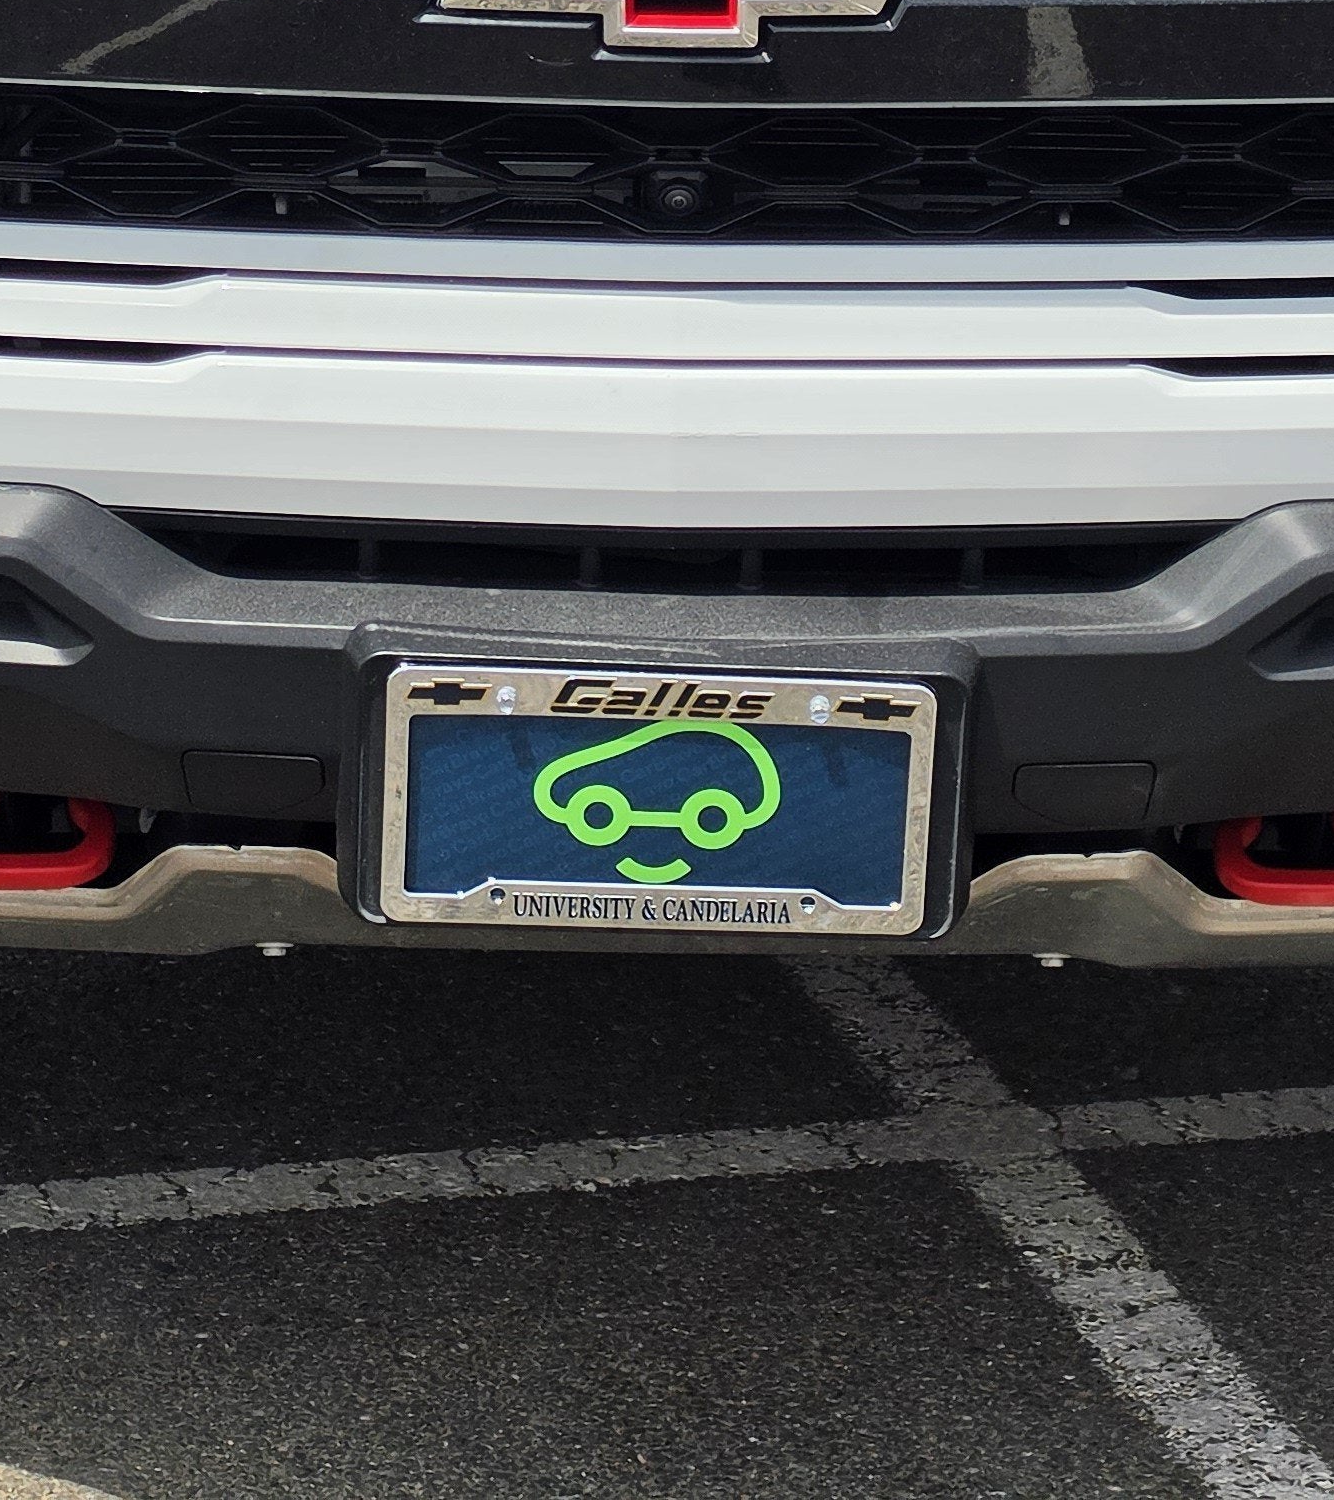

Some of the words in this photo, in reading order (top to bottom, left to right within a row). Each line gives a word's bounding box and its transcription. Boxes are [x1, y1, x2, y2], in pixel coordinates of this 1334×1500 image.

[550, 678, 775, 719] Galles
[512, 891, 636, 921] UNIVERSITY
[641, 896, 658, 921] &
[662, 897, 791, 925] CANDELARIA
